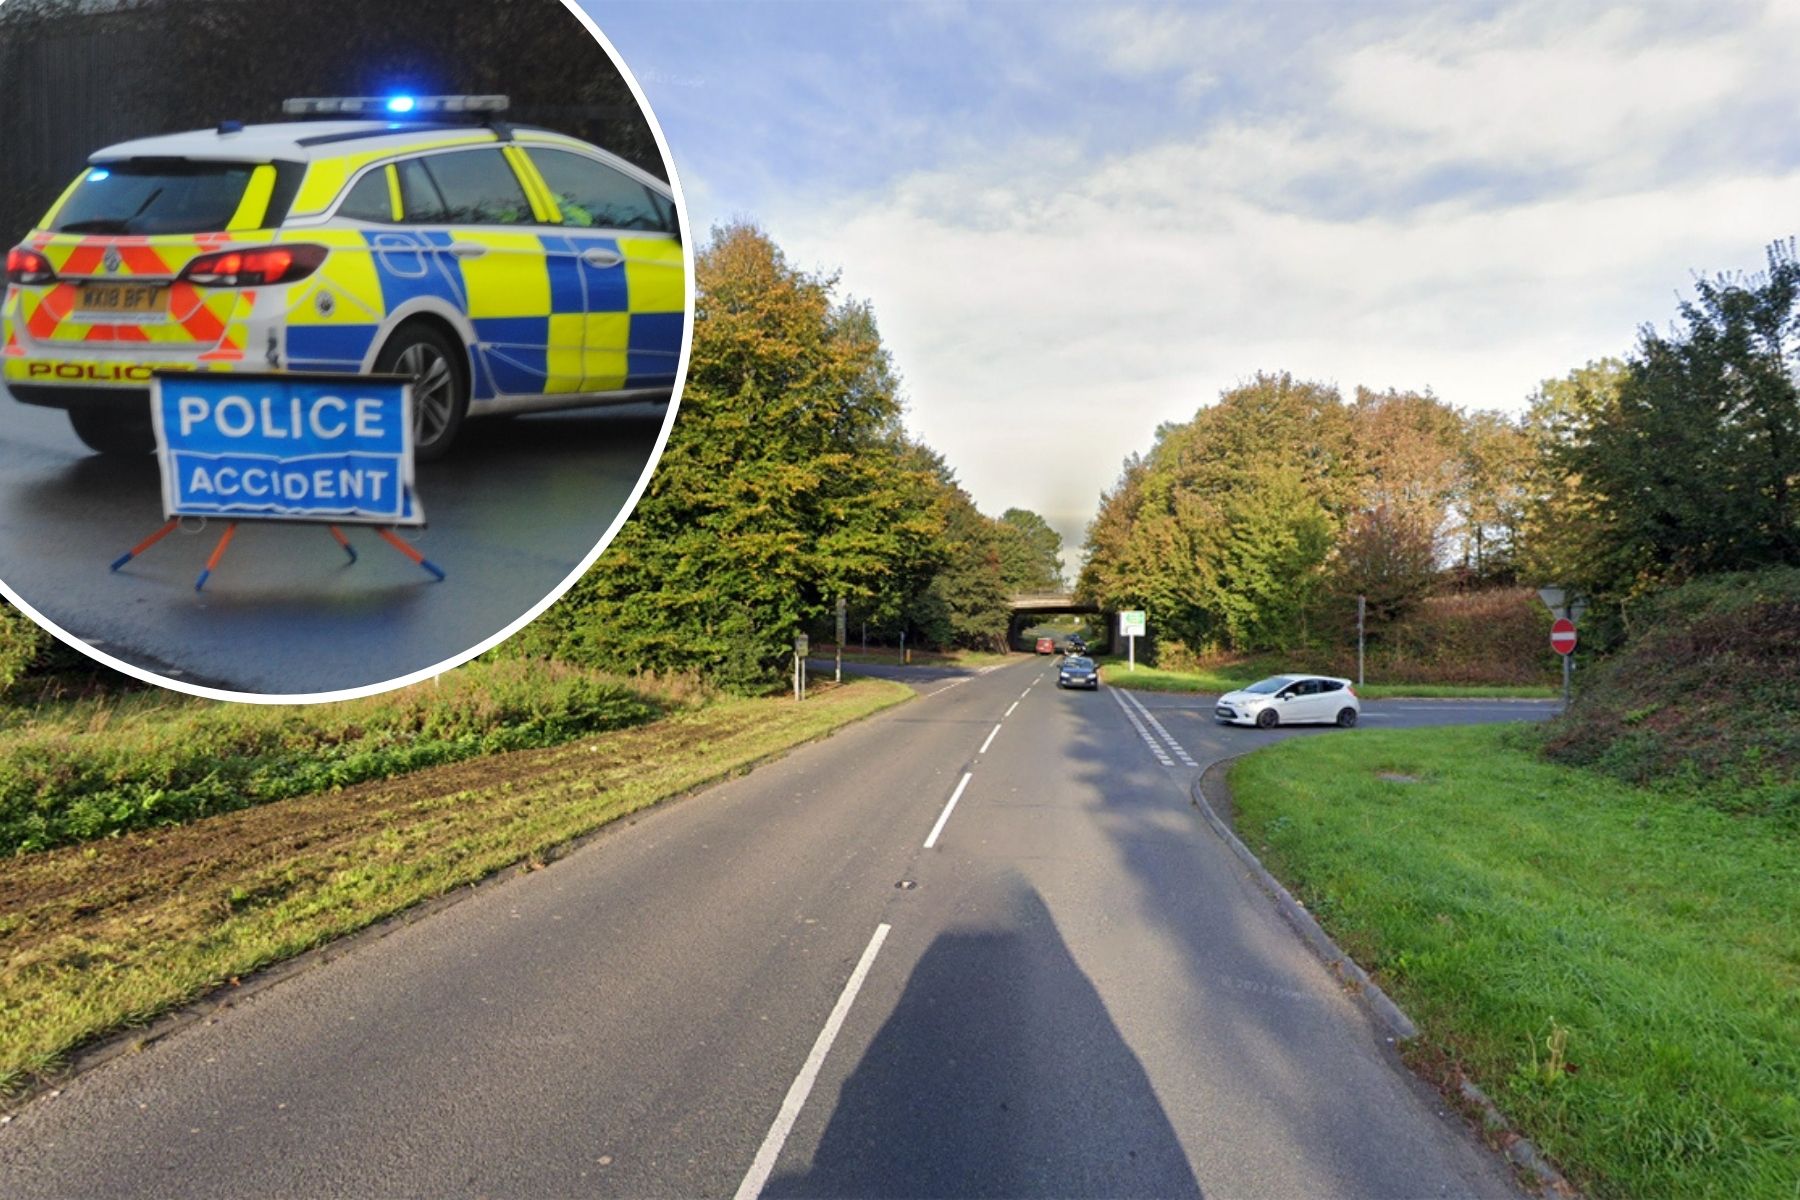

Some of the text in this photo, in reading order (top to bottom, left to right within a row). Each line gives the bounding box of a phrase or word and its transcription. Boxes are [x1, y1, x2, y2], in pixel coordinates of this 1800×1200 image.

[29, 363, 189, 380] POLIC
[179, 395, 385, 439] POLICE
[189, 466, 389, 501] ACCIDENT
